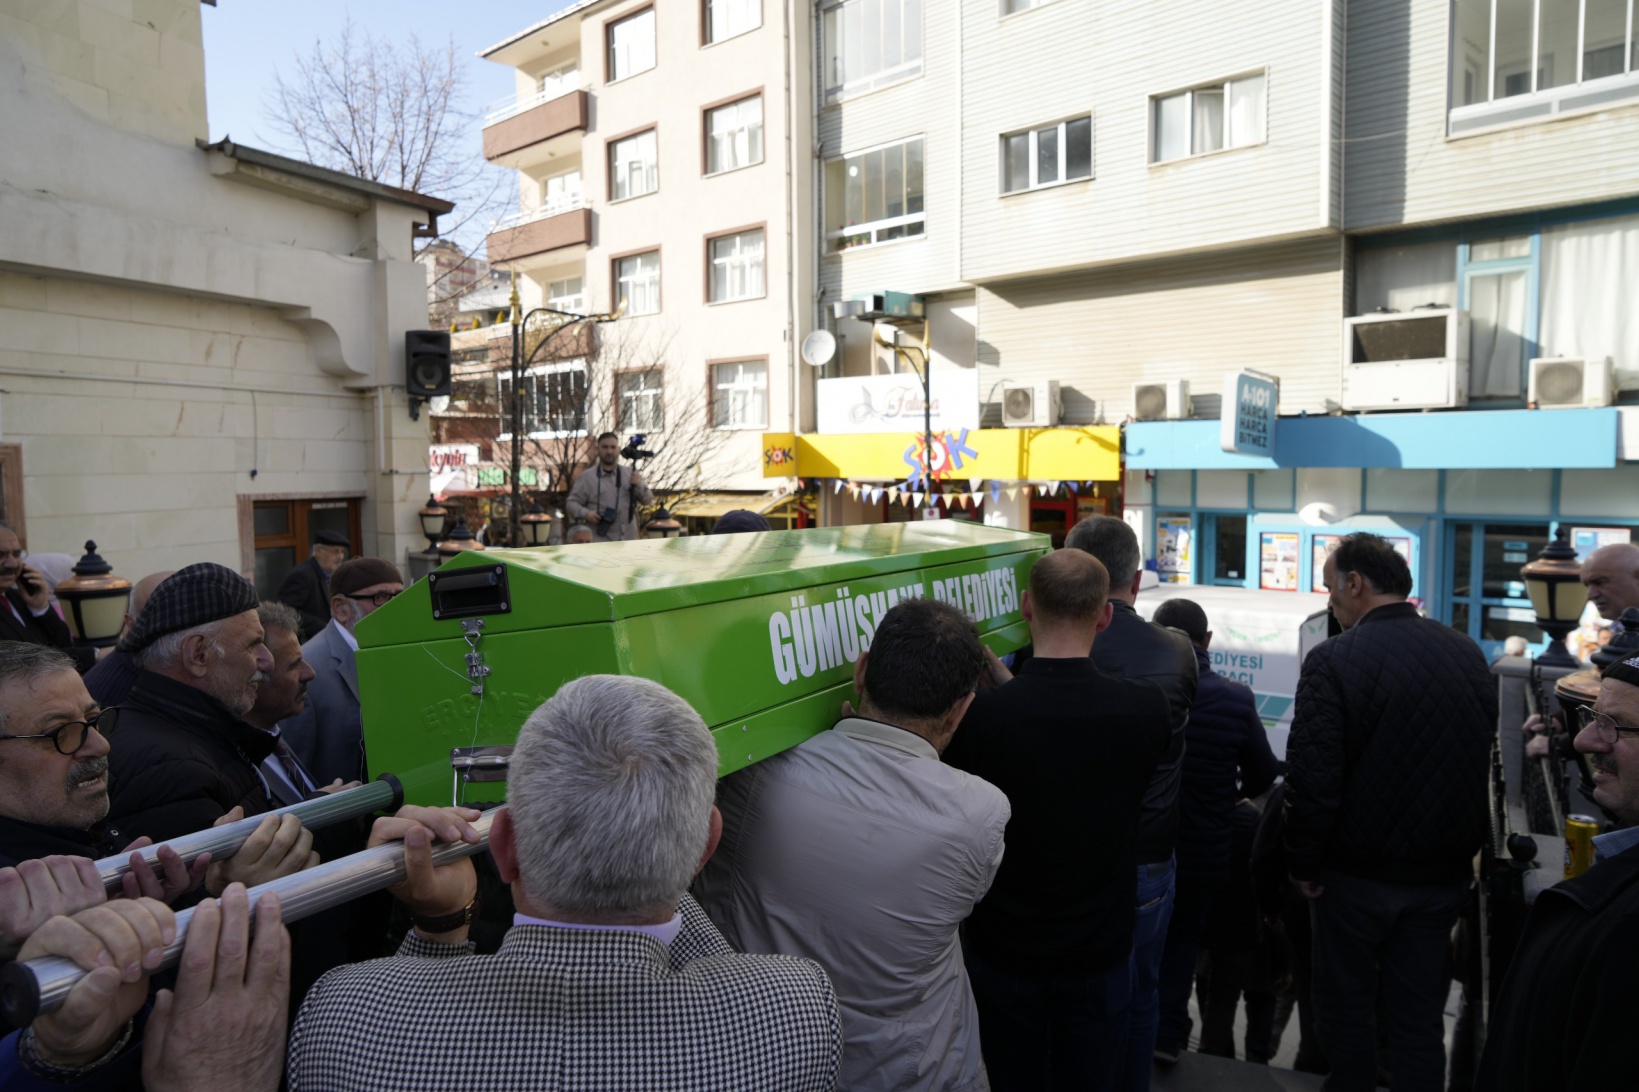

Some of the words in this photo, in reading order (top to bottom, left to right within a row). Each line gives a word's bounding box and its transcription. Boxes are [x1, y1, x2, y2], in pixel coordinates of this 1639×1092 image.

[1241, 402, 1268, 421] HARCA
[1240, 417, 1268, 434] HARCA
[765, 448, 794, 468] ŞOK
